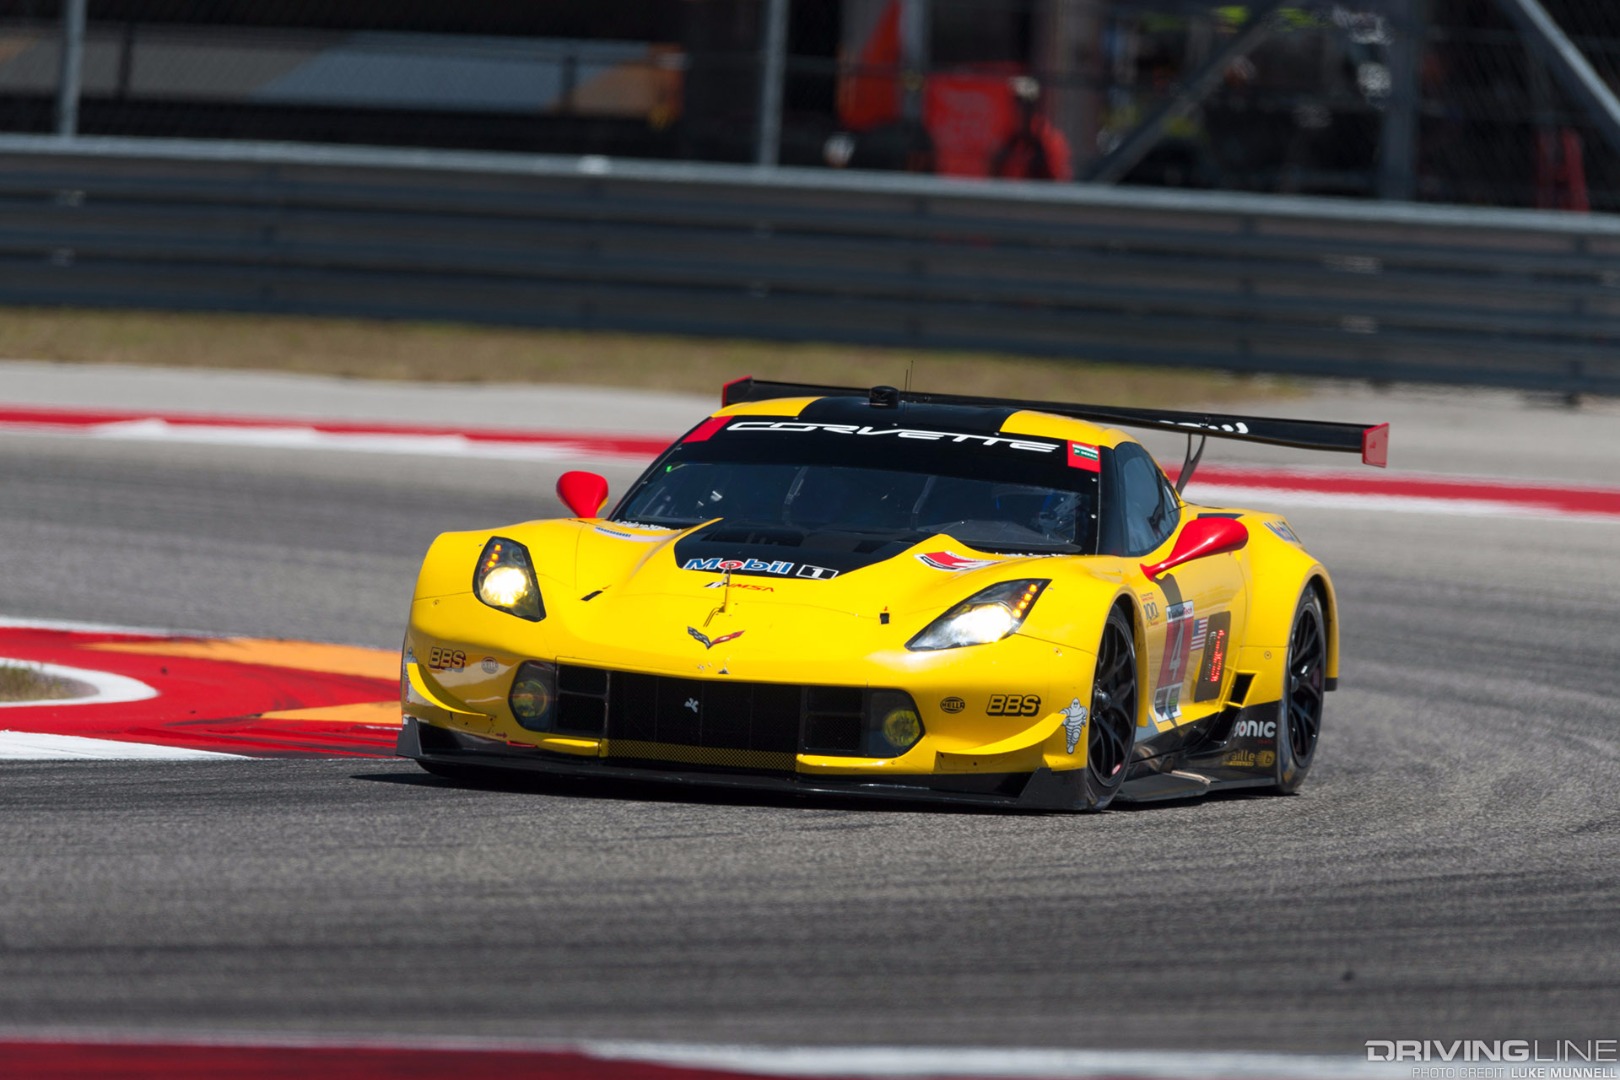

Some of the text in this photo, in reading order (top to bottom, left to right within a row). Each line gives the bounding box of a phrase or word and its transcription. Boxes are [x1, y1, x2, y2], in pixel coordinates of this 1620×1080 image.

[726, 421, 1060, 453] CORVETTE
[682, 558, 795, 575] Mobil
[428, 647, 466, 670] BBS
[1169, 620, 1185, 681] 4
[986, 694, 1041, 717] BBS
